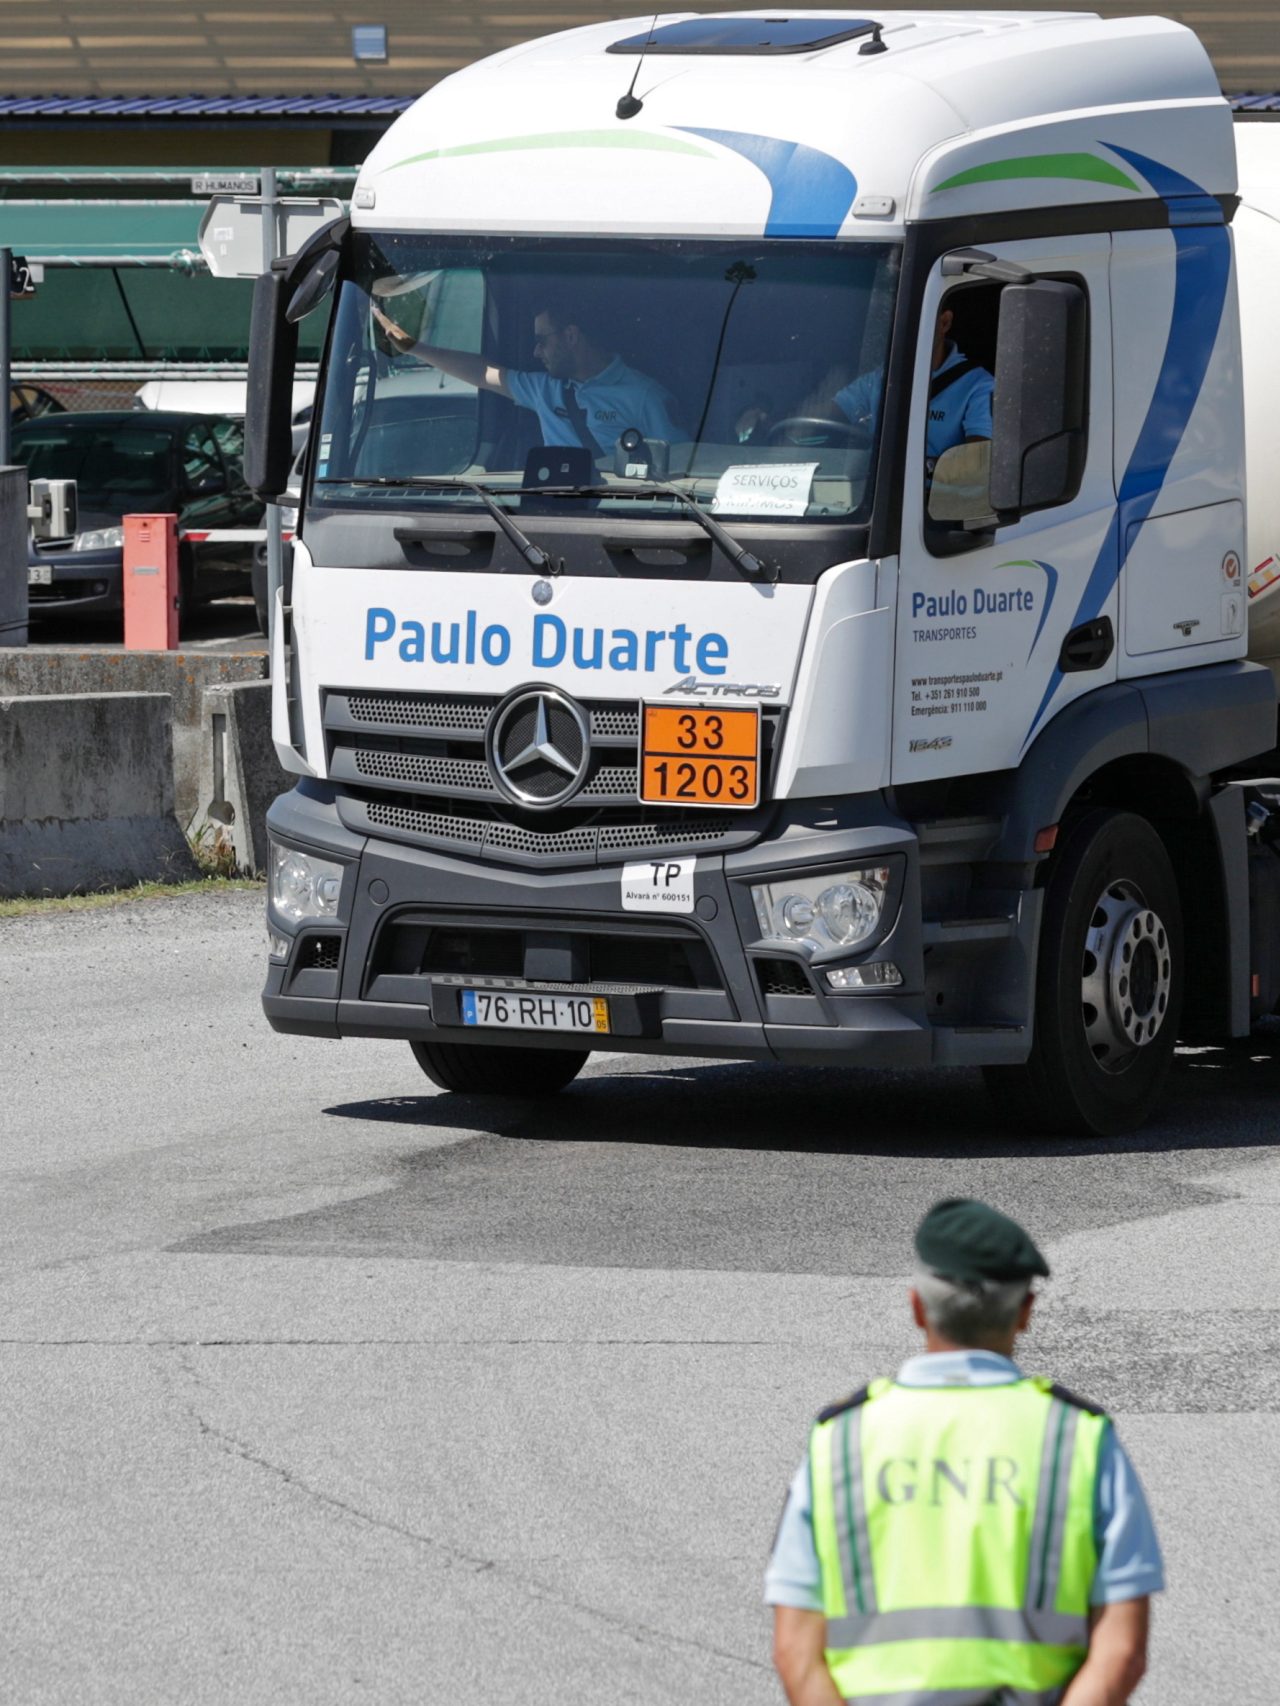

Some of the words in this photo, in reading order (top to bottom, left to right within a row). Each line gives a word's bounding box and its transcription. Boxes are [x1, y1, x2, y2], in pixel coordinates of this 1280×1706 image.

[206, 181, 254, 191] HUMANOS
[594, 410, 617, 421] GNR
[927, 409, 946, 421] NR
[731, 474, 799, 491] SERVIÇOS
[912, 589, 967, 618] Paulo
[973, 587, 1033, 615] Duarte
[365, 607, 511, 666] Paulo
[532, 613, 729, 675] Duarte
[913, 626, 977, 642] TRANSPORTES
[677, 714, 724, 750] 33
[653, 762, 749, 799] 1203
[650, 862, 681, 887] TP
[661, 893, 690, 902] 600151
[877, 1454, 1026, 1508] GNR
